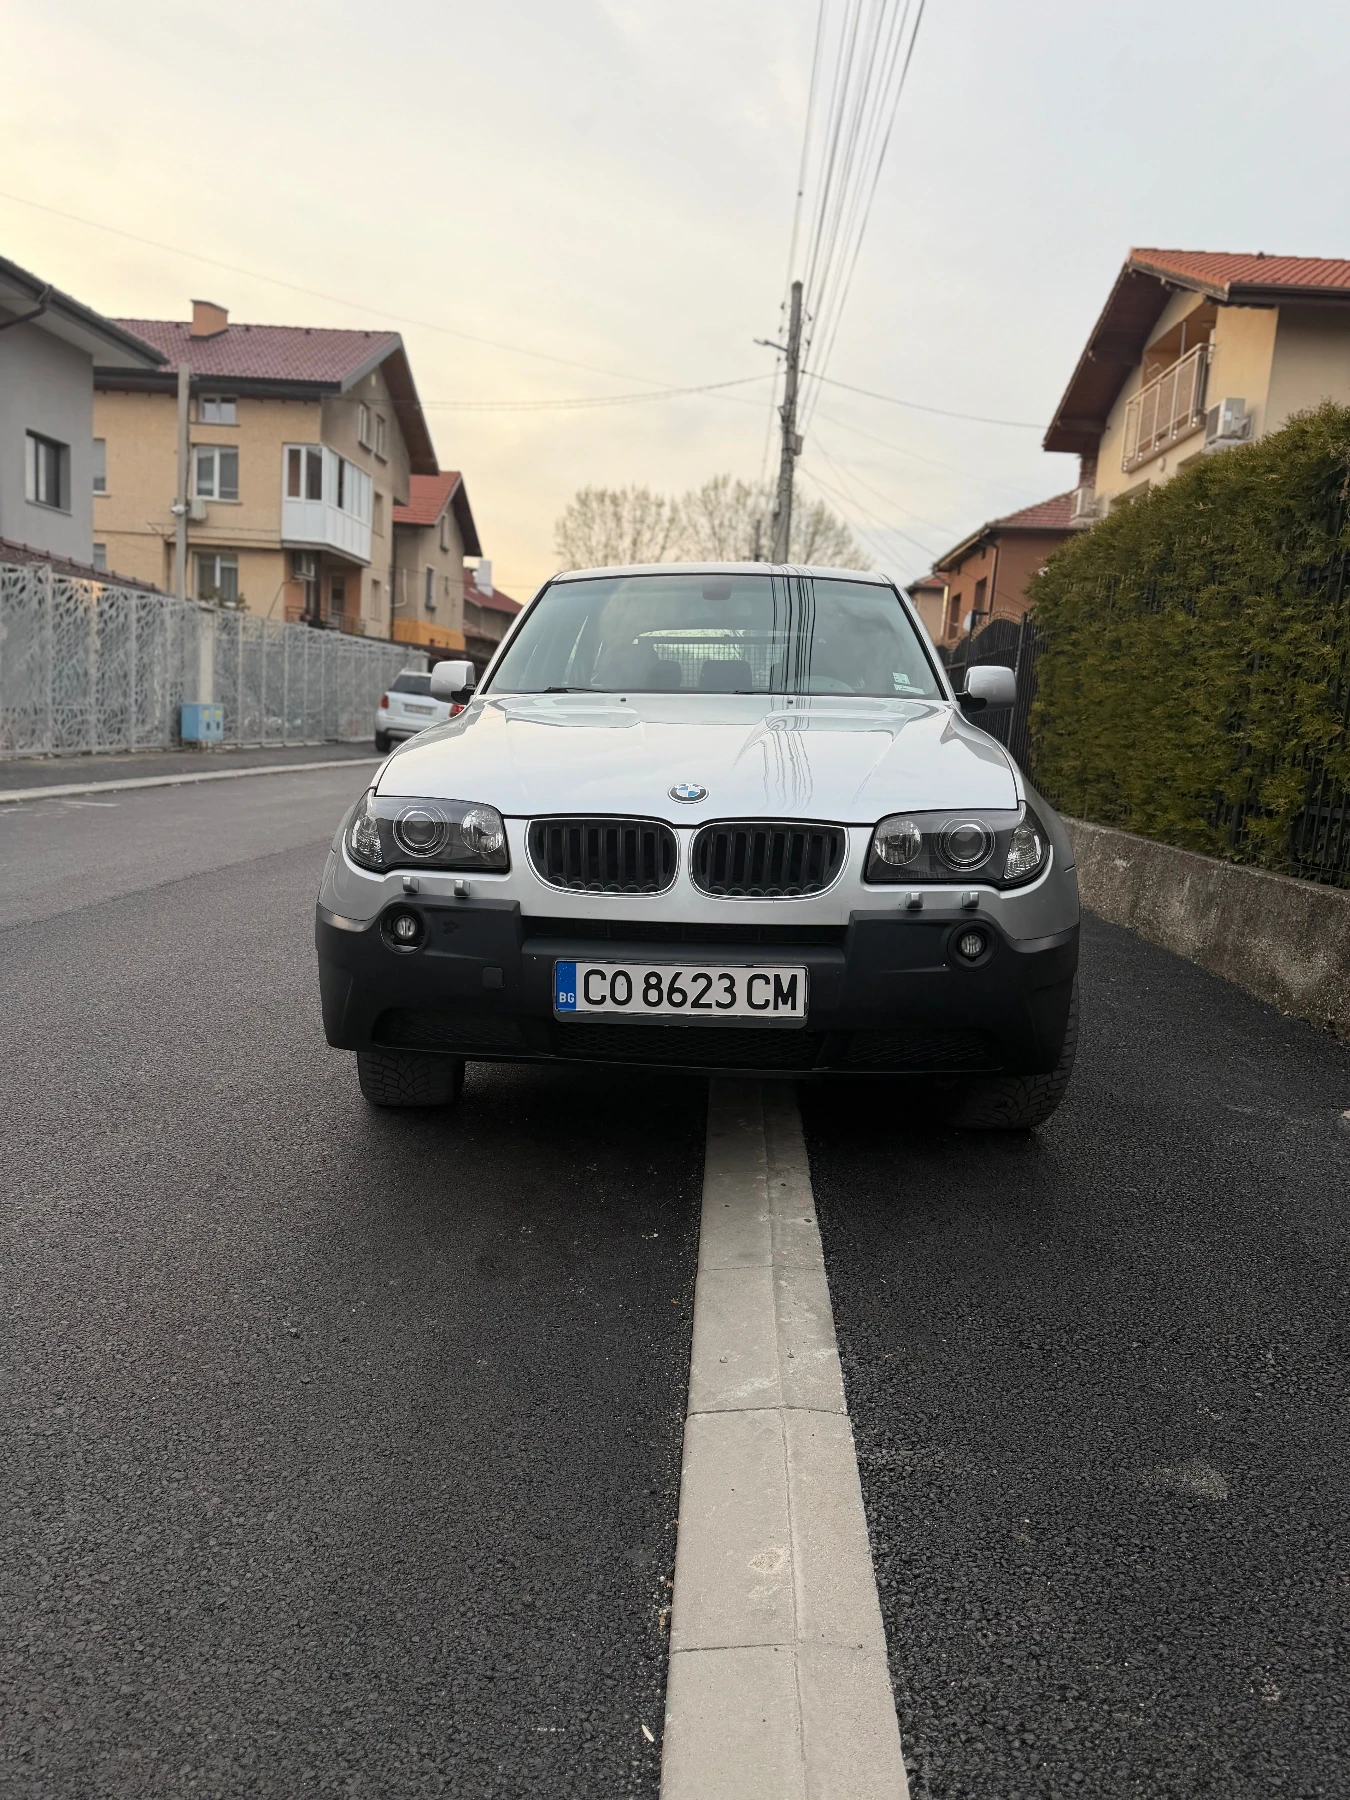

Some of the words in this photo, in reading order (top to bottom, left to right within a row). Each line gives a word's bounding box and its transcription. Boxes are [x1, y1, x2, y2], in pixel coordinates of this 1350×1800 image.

[559, 992, 575, 1004] BG
[583, 969, 633, 1006] CO
[642, 970, 737, 1010] 8623
[746, 973, 798, 1011] CM
